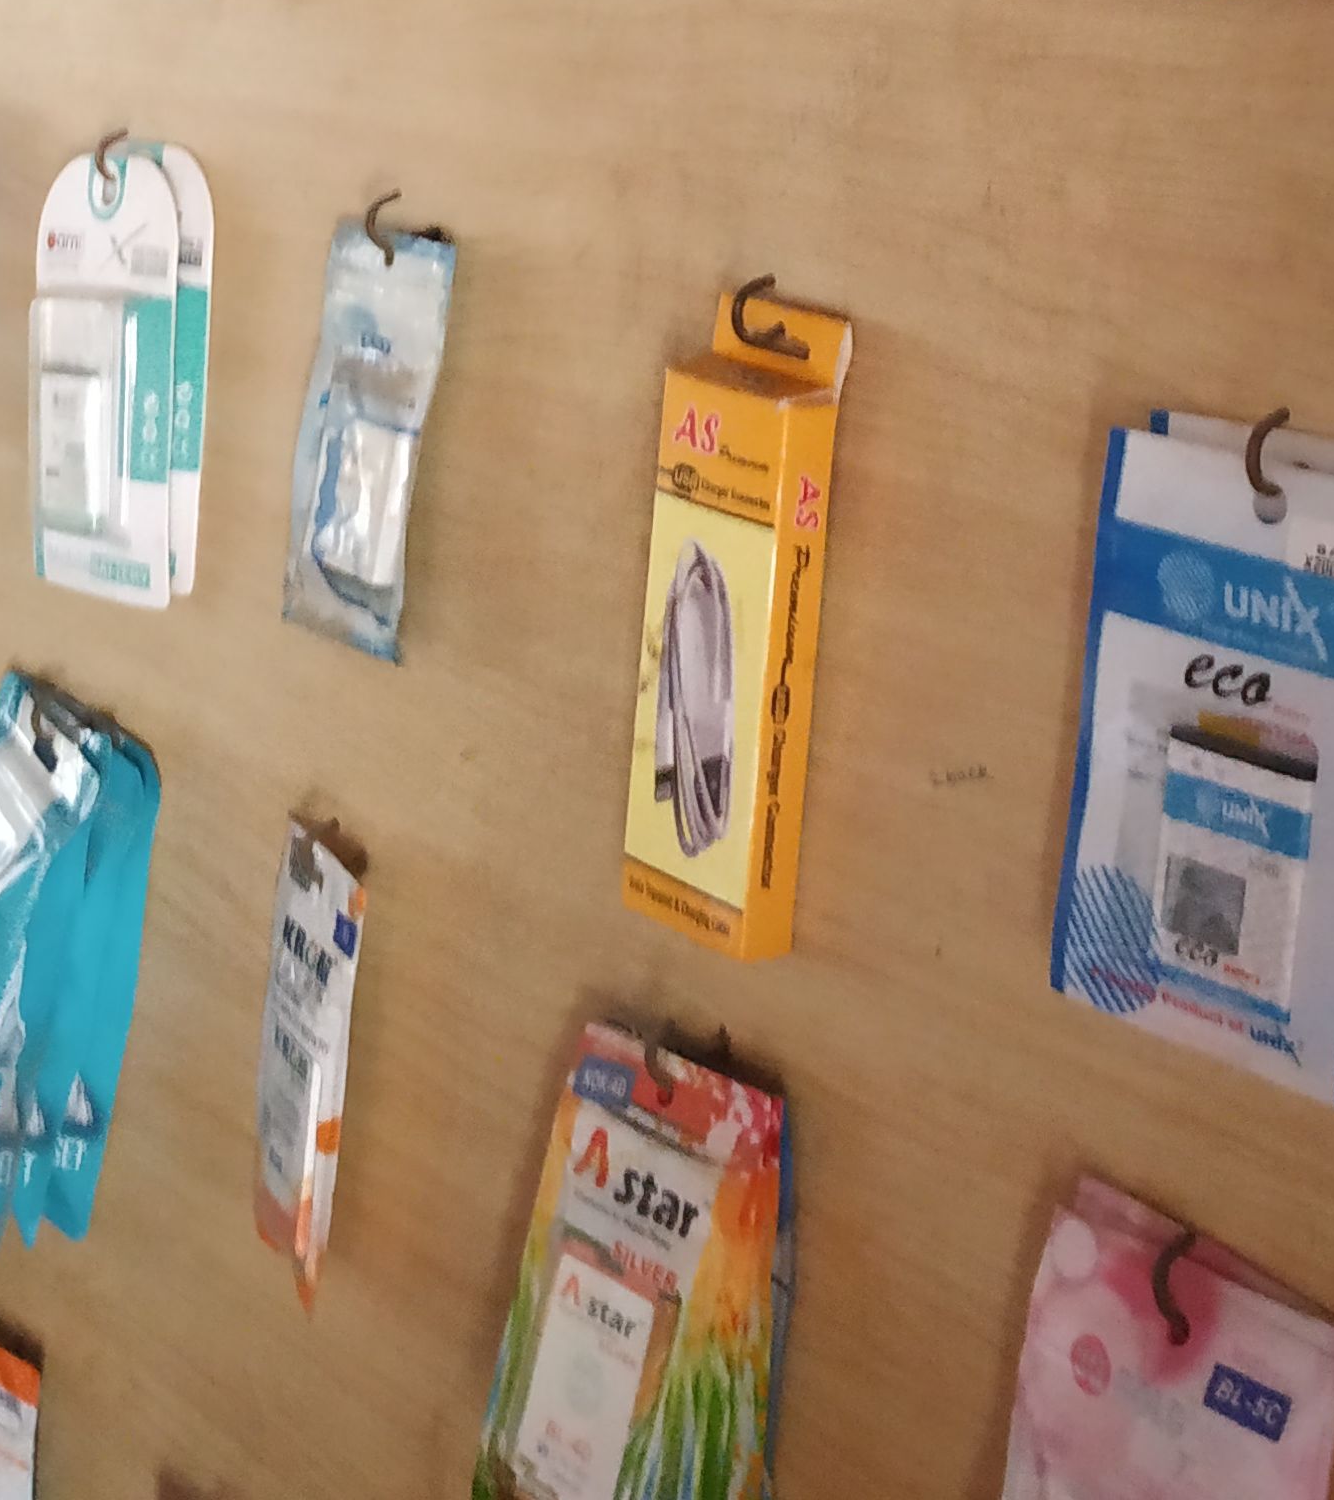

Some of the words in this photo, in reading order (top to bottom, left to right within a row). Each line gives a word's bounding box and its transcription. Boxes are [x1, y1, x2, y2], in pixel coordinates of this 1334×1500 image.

[674, 406, 719, 453] AS
[799, 474, 821, 529] AS
[784, 543, 811, 678] Premium
[1223, 576, 1328, 663] UNIX
[1184, 653, 1273, 707] eco
[1162, 991, 1223, 1027] Product
[613, 1167, 700, 1239] star
[612, 1240, 679, 1290] SILVER
[586, 1296, 638, 1339] star
[1213, 1377, 1284, 1427] BL-5C
